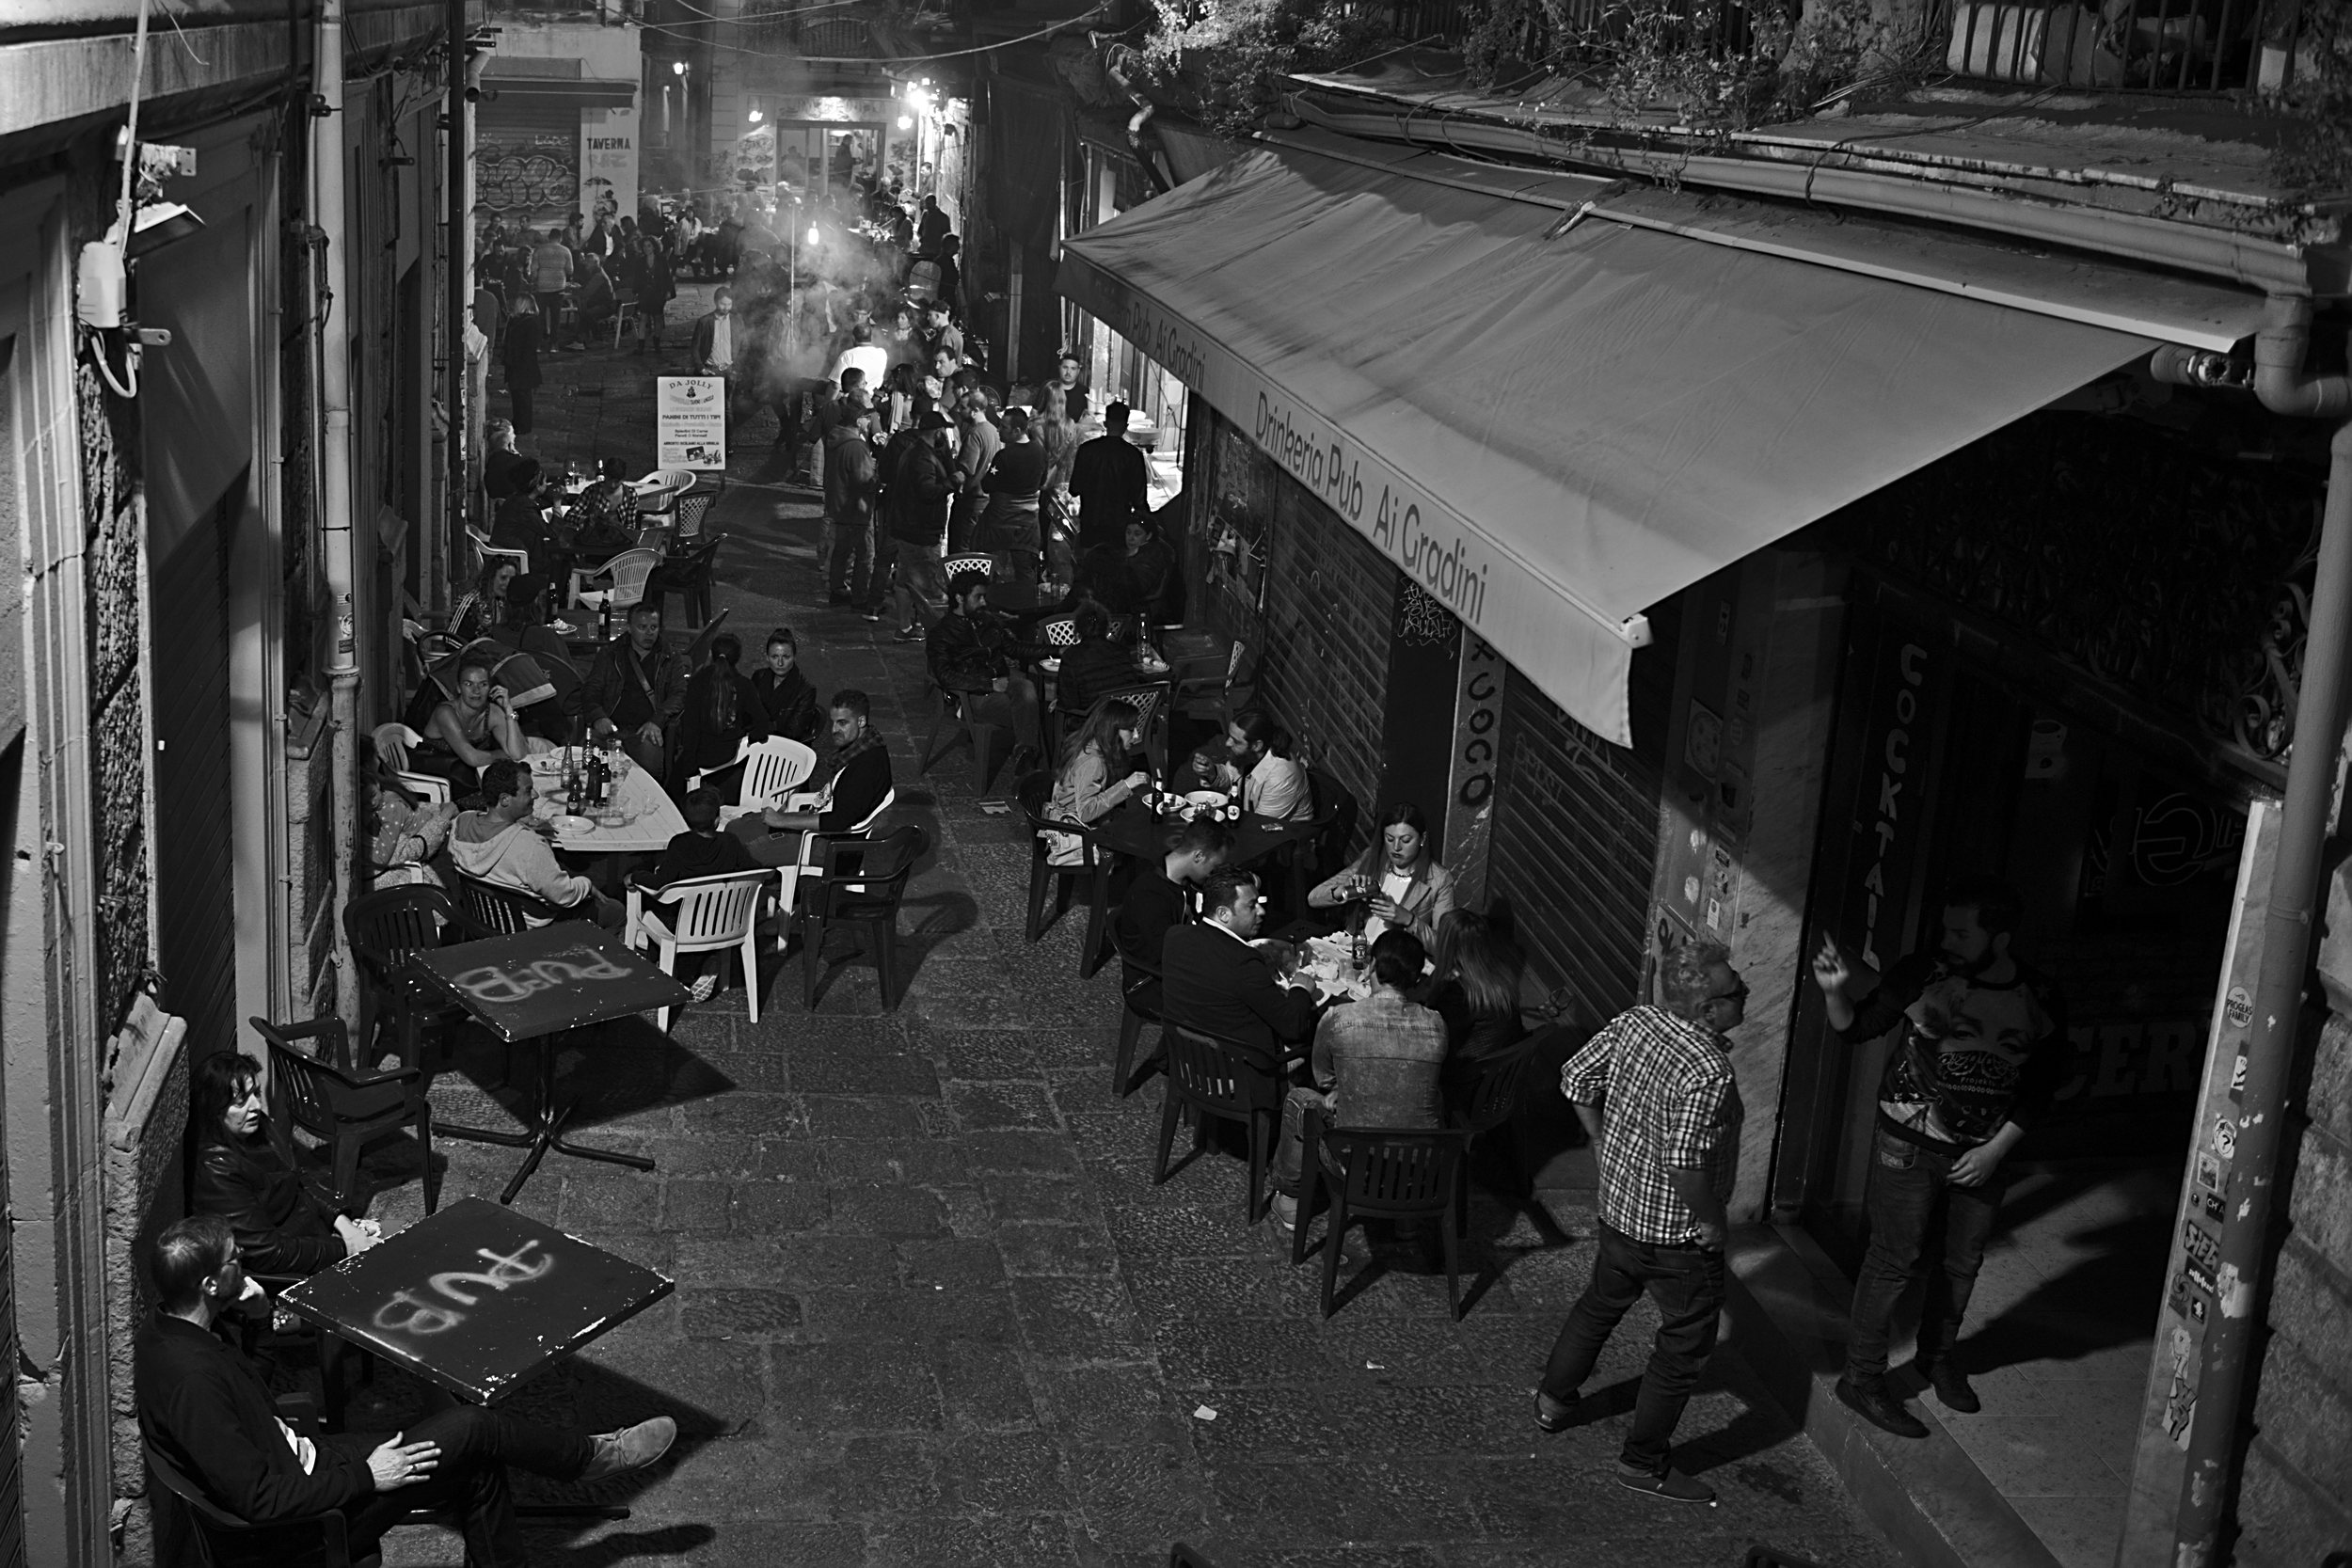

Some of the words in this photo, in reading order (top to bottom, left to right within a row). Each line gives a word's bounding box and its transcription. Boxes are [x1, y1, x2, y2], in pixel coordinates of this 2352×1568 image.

[587, 137, 631, 150] TAVERNA
[1133, 301, 1151, 346] Pub
[1154, 318, 1168, 360] Ai
[1168, 327, 1206, 391] Gradini
[669, 381, 683, 389] DA
[685, 379, 713, 389] JOLLY
[1255, 390, 1324, 487] Drinkeria
[1327, 444, 1362, 522] Pub
[1374, 484, 1399, 552] Ai
[1403, 503, 1488, 626] Gradini
[1861, 642, 1927, 973] COCKTAIL
[2229, 1009, 2249, 1023] FAMILY
